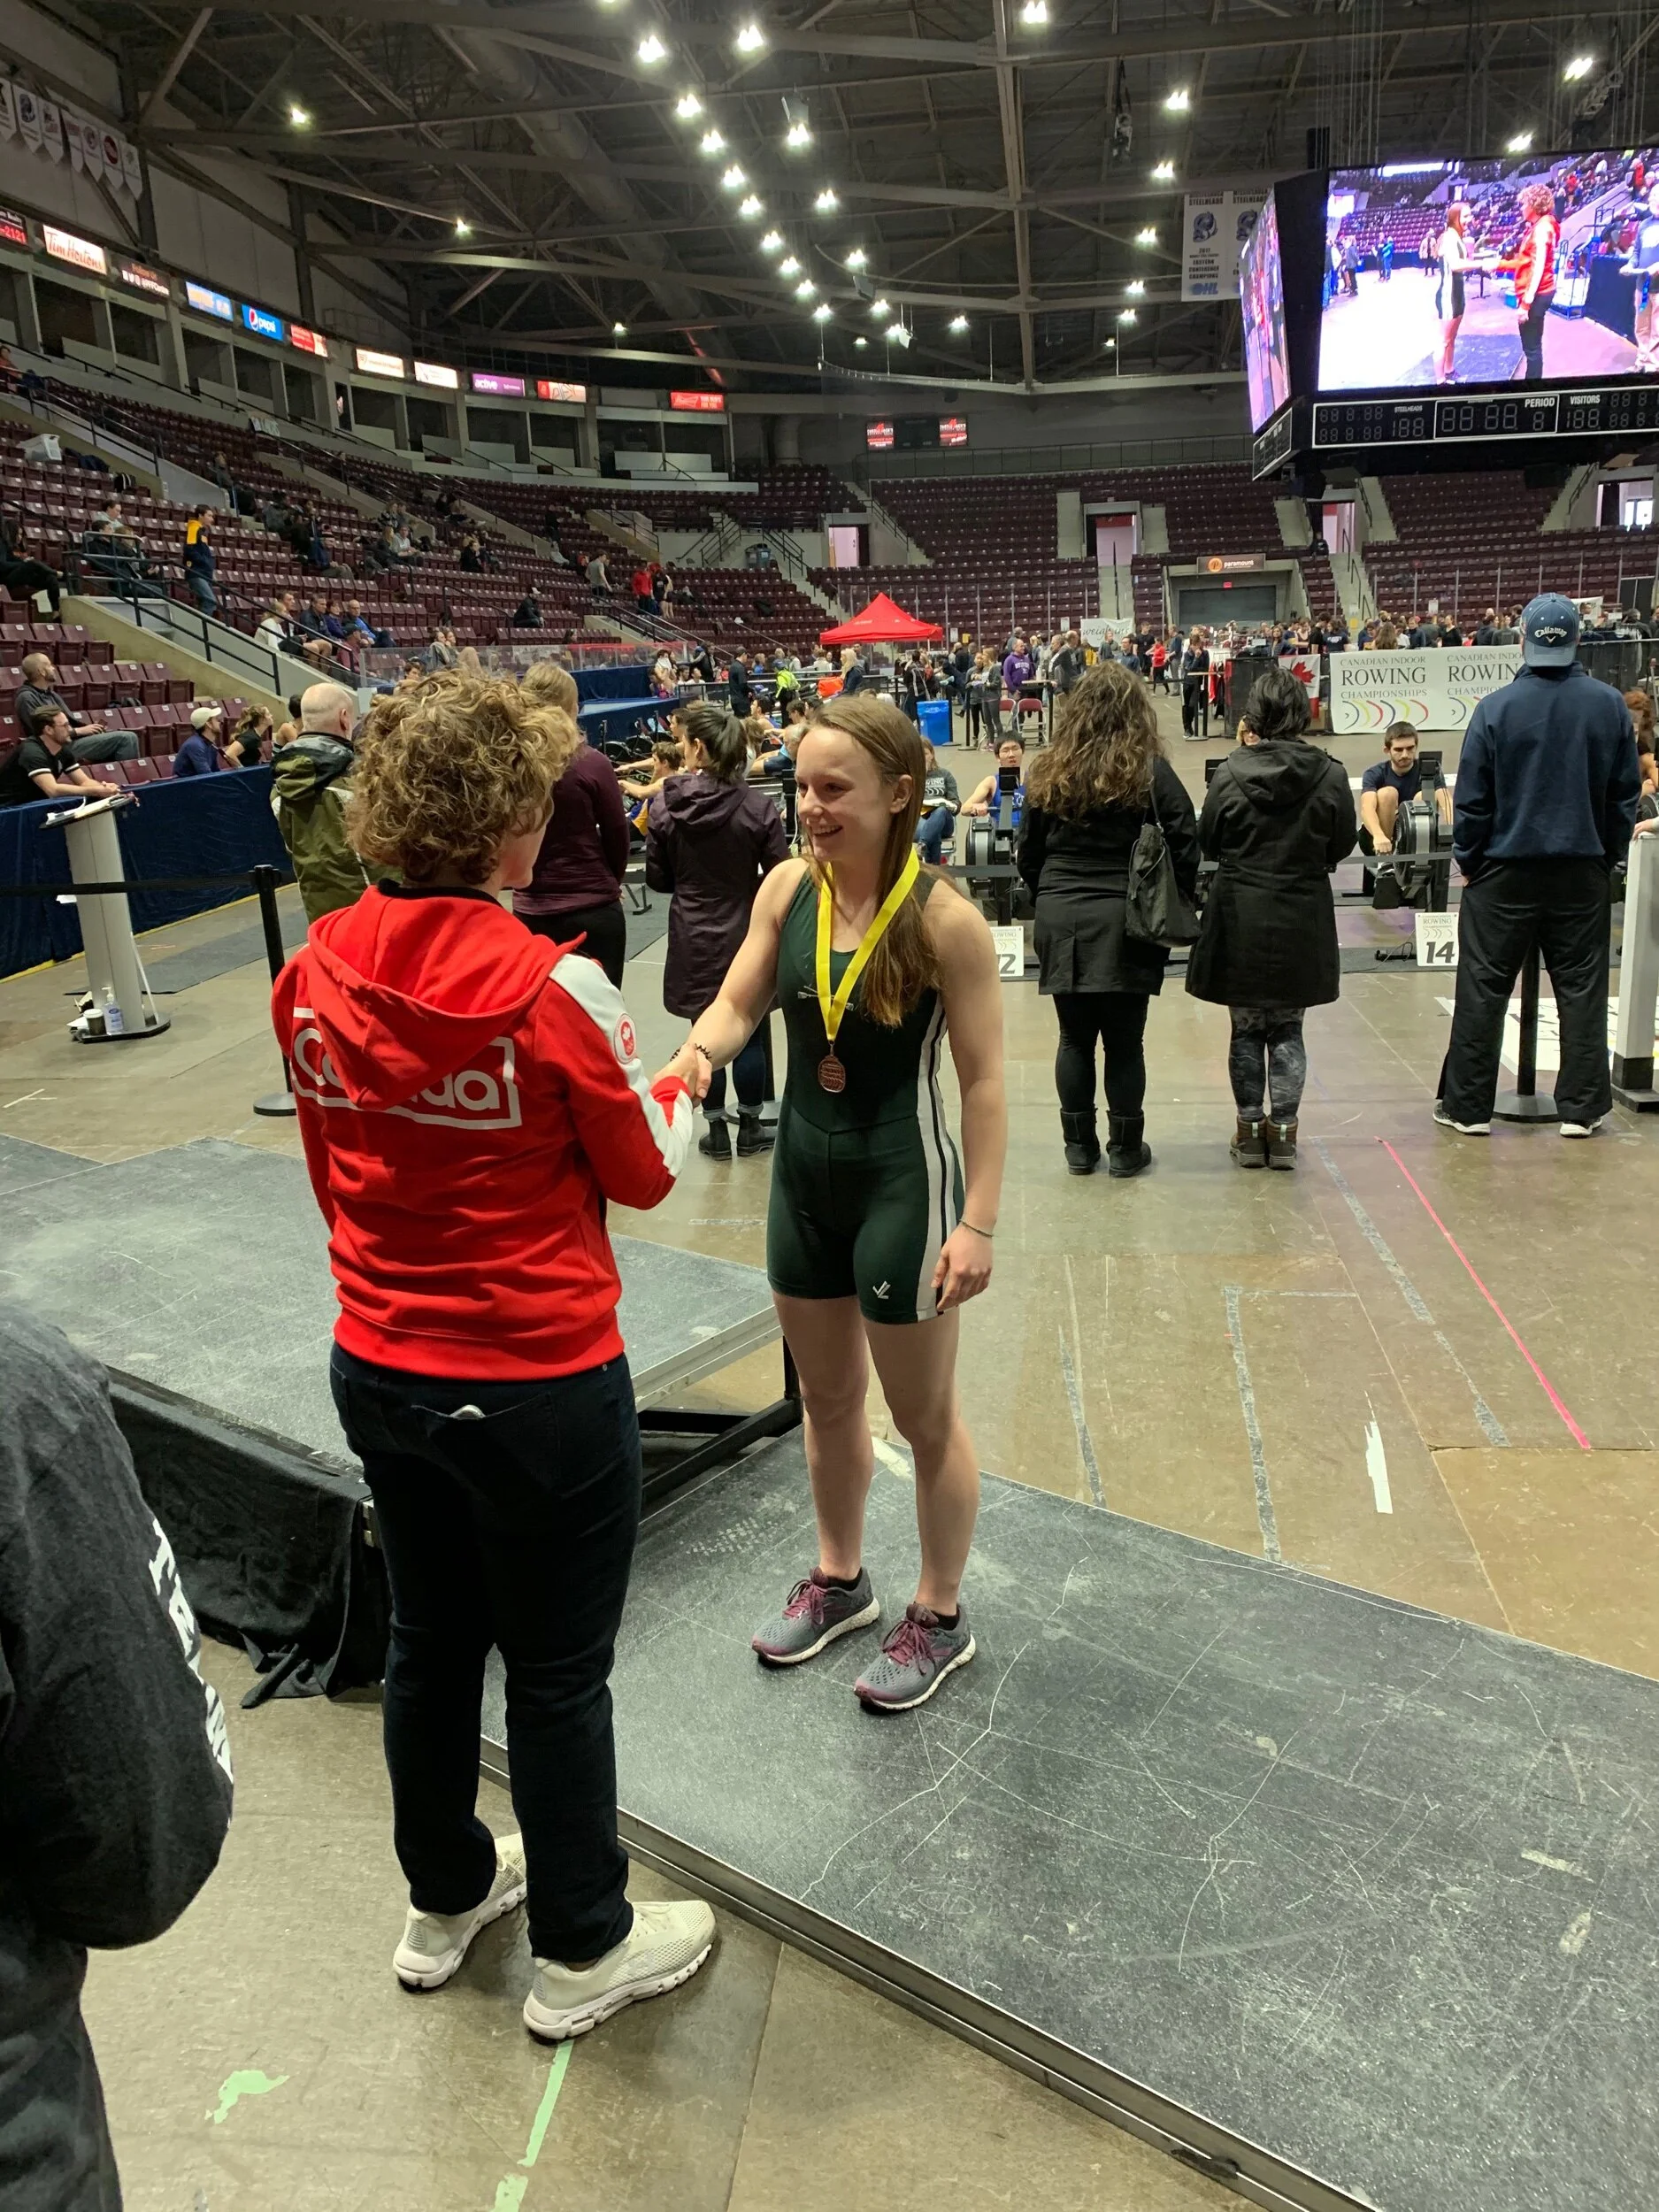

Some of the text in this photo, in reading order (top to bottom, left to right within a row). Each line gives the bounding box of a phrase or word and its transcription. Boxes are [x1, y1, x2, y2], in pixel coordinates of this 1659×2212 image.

[46, 232, 65, 256] Tim
[67, 239, 104, 273] Hortons
[258, 318, 276, 334] pepsi
[475, 379, 498, 390] active
[1525, 397, 1555, 409] PERIOD
[1570, 395, 1601, 405] VISITORS
[1224, 559, 1255, 568] paramount
[1534, 626, 1568, 638] Callaway
[1340, 656, 1426, 667] CANADIAN INDOOR
[1447, 652, 1497, 663] CANADIAN
[1341, 666, 1426, 687] ROWING
[1448, 663, 1519, 683] ROWIN
[1340, 689, 1428, 699] CHAMPIONSHIPS
[1426, 941, 1455, 964] 14
